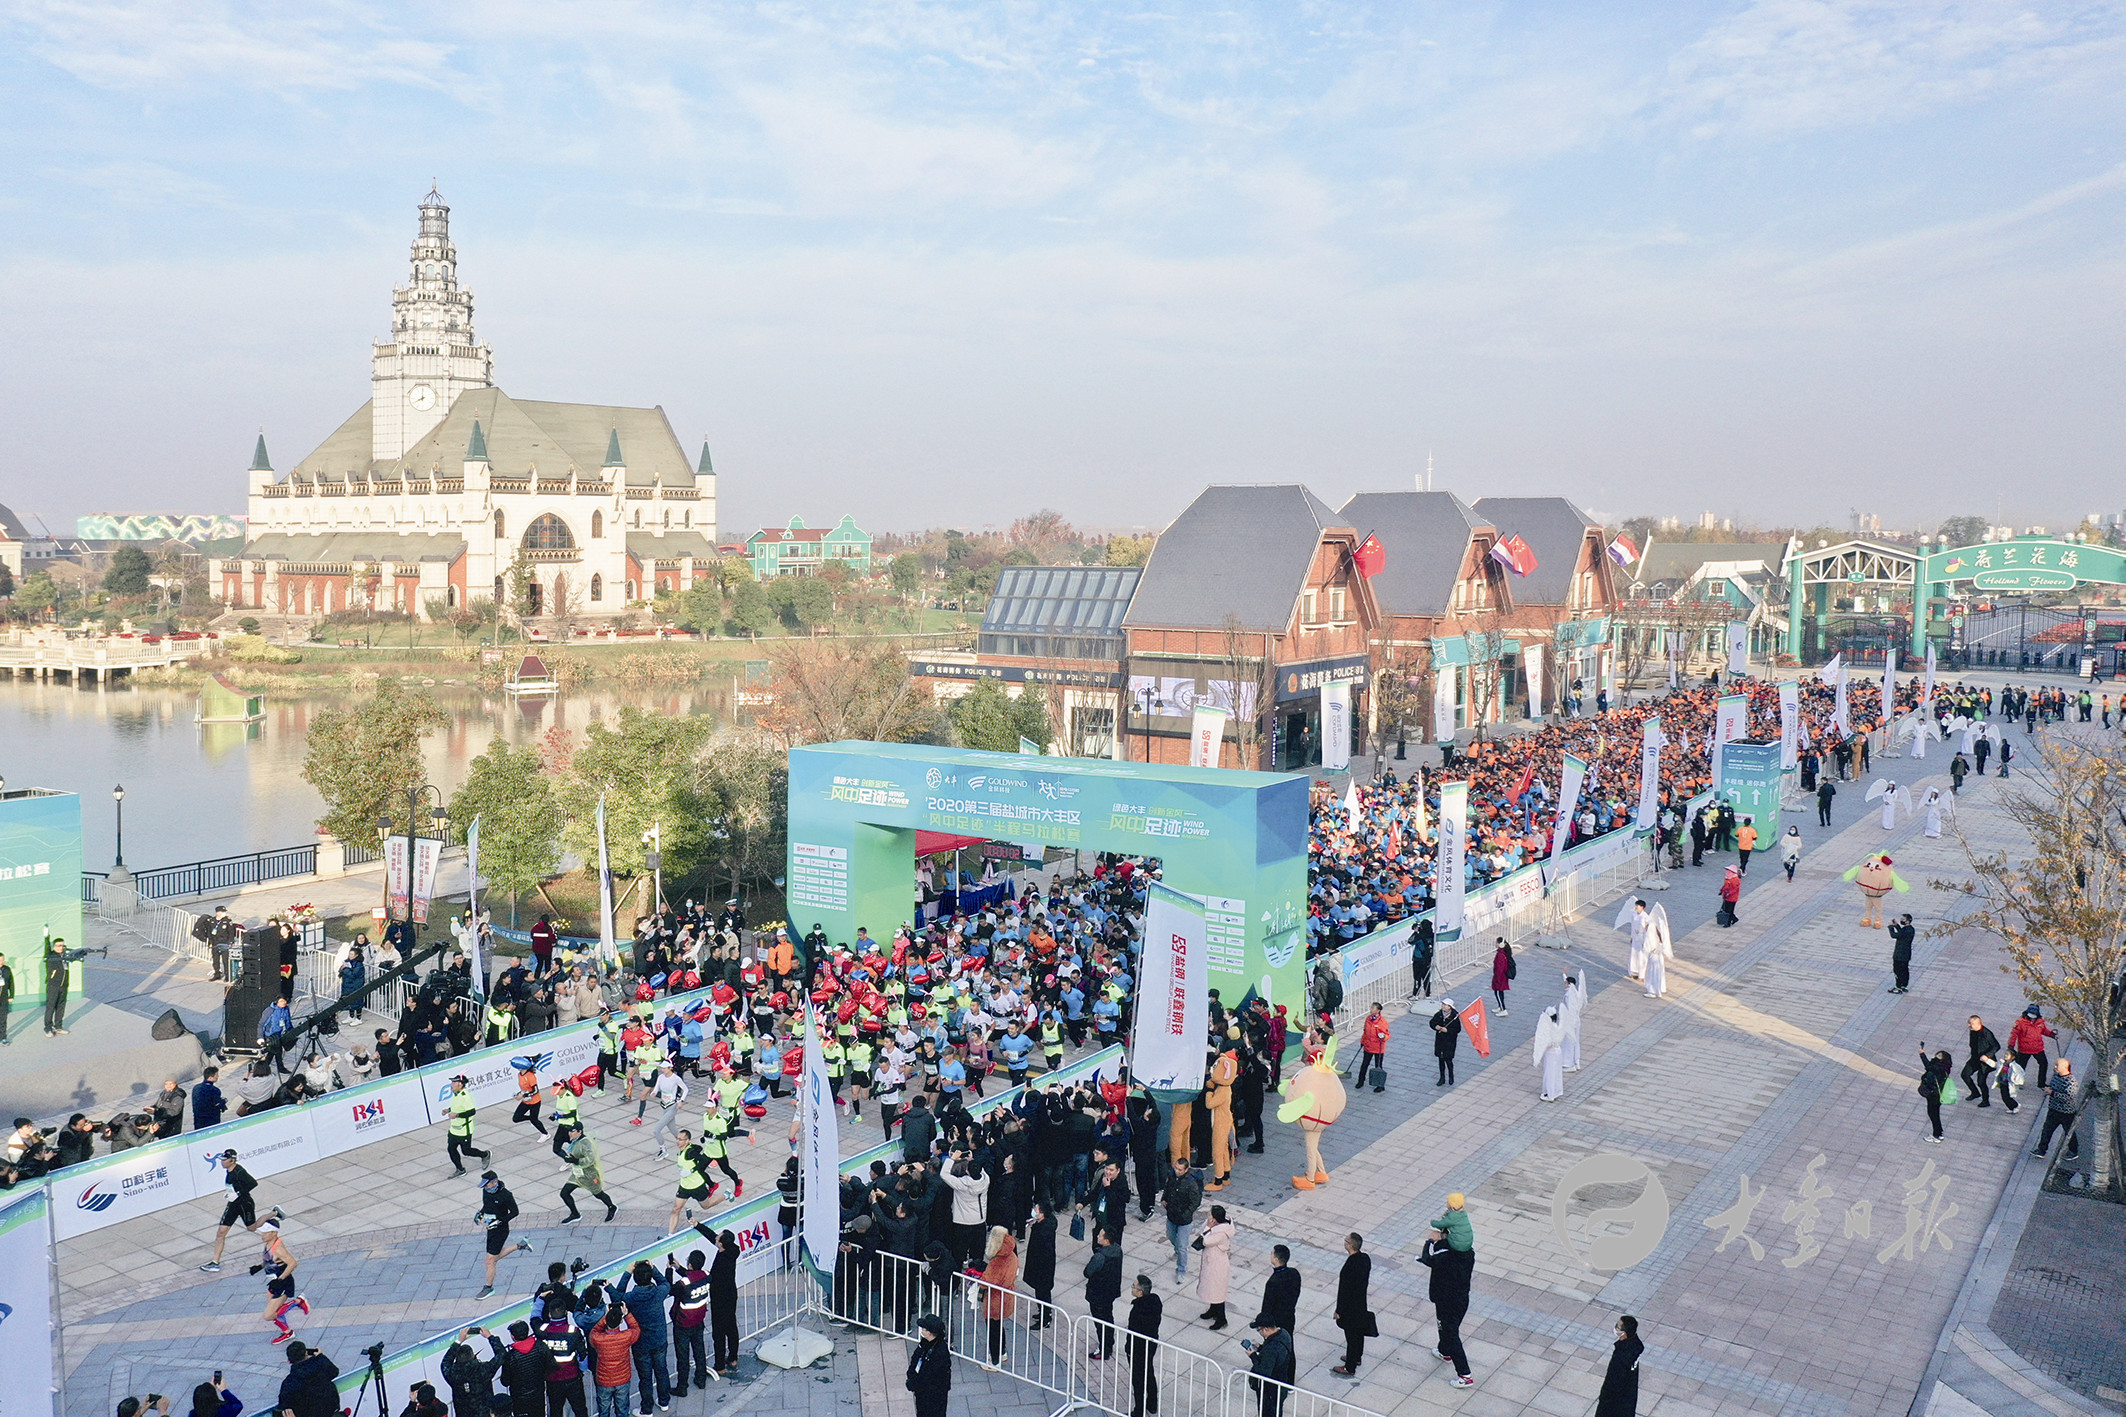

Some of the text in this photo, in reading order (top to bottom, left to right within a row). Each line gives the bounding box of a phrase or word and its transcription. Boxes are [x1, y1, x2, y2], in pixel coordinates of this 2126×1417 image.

[1974, 546, 2079, 568] 荷兰花海
[1984, 576, 2067, 586] Holland Flowers
[964, 668, 988, 676] POLICE
[1333, 666, 1354, 678] POLICE
[988, 777, 1028, 788] GOLDWIND
[830, 785, 888, 806] 风中足迹
[888, 790, 905, 798] WIND
[888, 796, 910, 805] POWER
[1112, 803, 1184, 818] 绿色大丰 创新金风
[1109, 814, 1182, 838] 风中足迹
[1183, 820, 1205, 829] WIND
[1182, 827, 1210, 837] POWER
[1444, 838, 1454, 893] 金风体育文化
[1170, 954, 1186, 1036] 盐钢 联鑫钢铁
[121, 1166, 169, 1190] 中科宇能
[123, 1178, 170, 1198] Sino-wind
